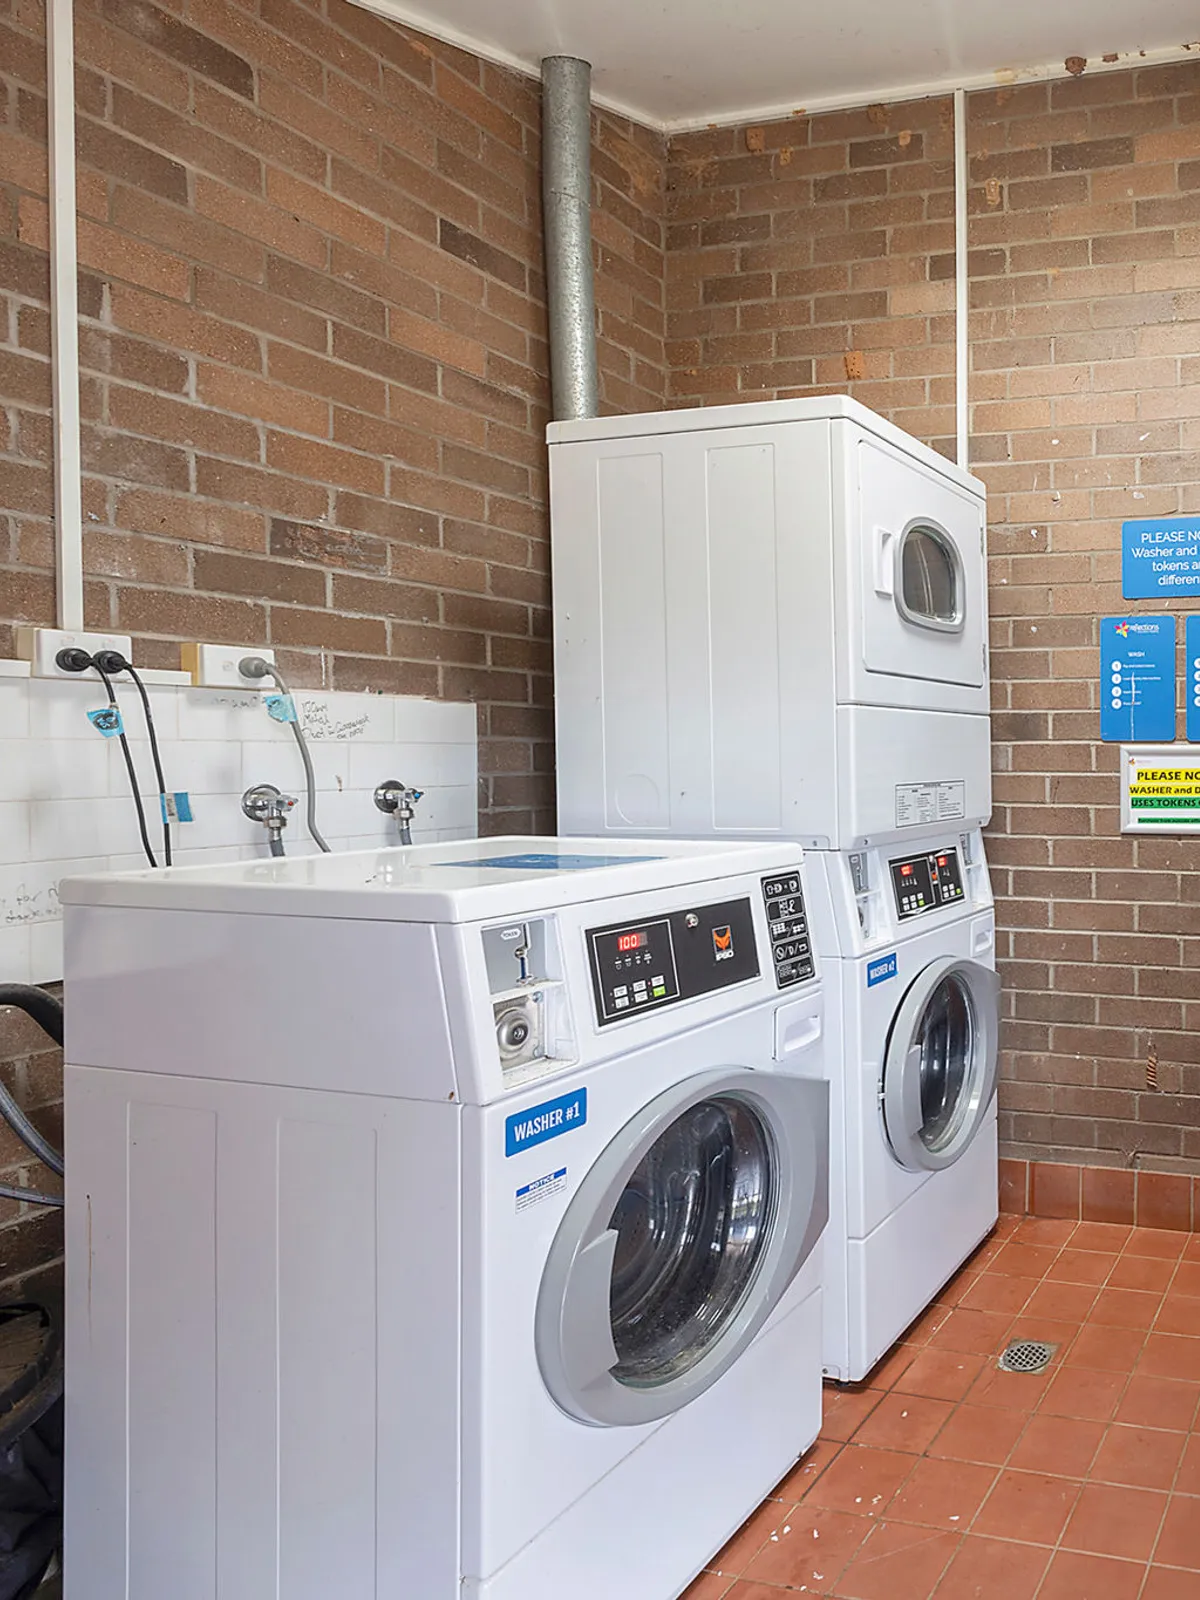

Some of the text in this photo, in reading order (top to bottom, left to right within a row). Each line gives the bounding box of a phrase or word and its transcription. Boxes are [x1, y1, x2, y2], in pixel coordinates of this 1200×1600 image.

[1141, 532, 1185, 543] PLEASE
[1132, 547, 1173, 558] Washer
[1176, 546, 1198, 556] and
[1153, 561, 1189, 572] tokens
[1137, 772, 1181, 781] PLEASE
[1132, 799, 1154, 807] USES
[1157, 799, 1196, 807] TOKENS
[619, 935, 637, 950] 100
[514, 1102, 580, 1142] WASHER #1
[529, 1173, 555, 1191] NOTICE
